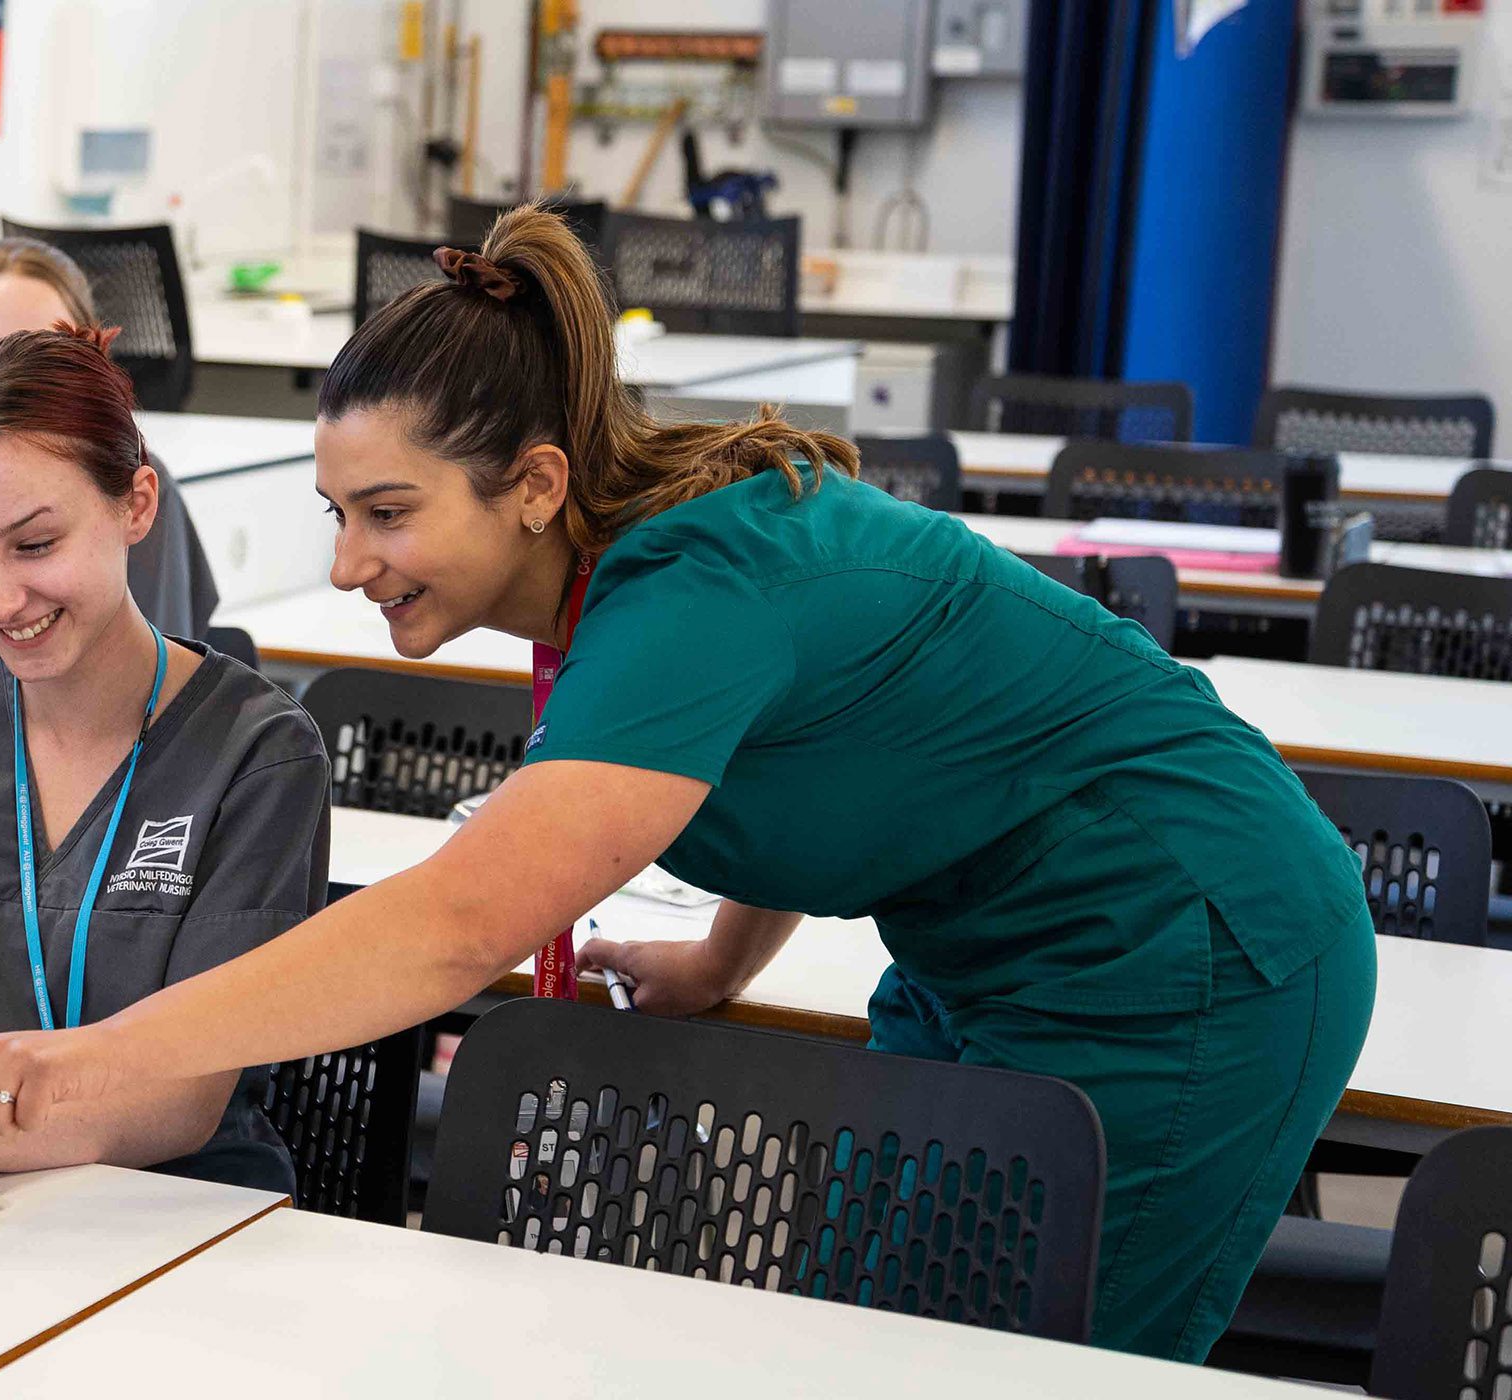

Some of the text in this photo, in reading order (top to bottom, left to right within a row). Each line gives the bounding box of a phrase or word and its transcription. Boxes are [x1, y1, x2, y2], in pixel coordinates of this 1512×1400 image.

[139, 838, 185, 848] Coleg Gwent
[106, 882, 192, 896] VETERINARY NURSING
[541, 973, 557, 998] oleg
